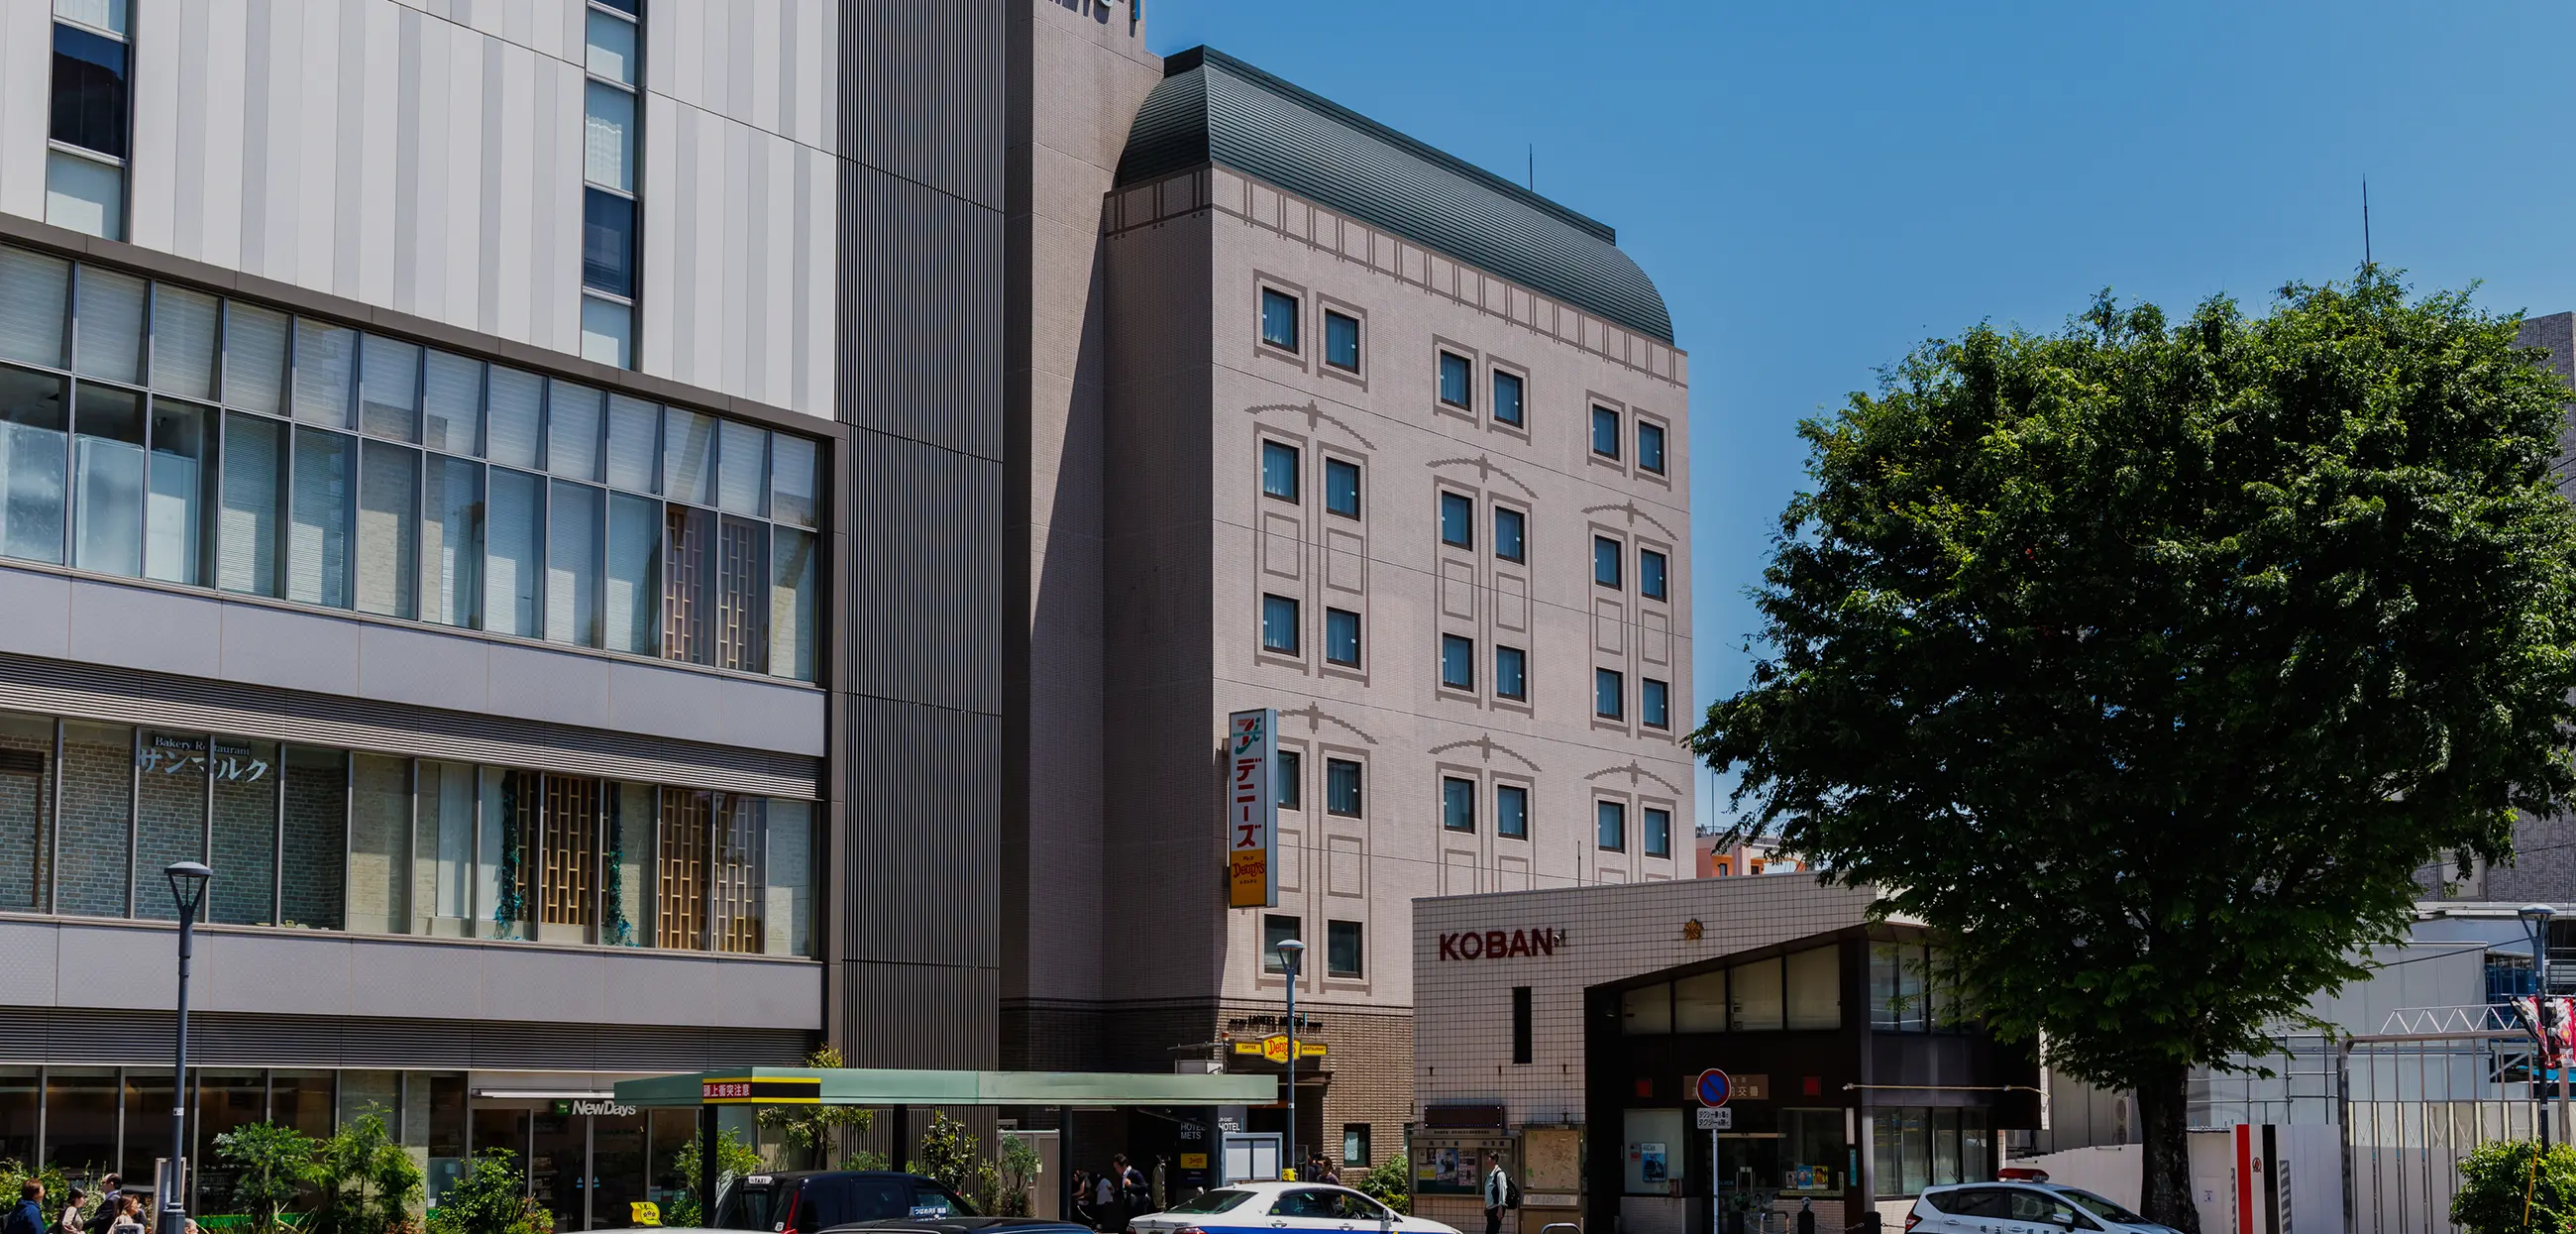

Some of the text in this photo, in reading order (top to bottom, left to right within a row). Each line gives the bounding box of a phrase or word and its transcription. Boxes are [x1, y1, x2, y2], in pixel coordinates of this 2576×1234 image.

[155, 736, 250, 755] Bakery Rtaurant
[140, 747, 268, 783] サンマルク
[1236, 757, 1262, 848] デニーズ
[1233, 859, 1265, 878] Denny's
[1440, 928, 1553, 961] KOBAN
[703, 1083, 750, 1097] 頭上衝突注意
[572, 1100, 637, 1117] NewDays
[1180, 1131, 1202, 1140] METS
